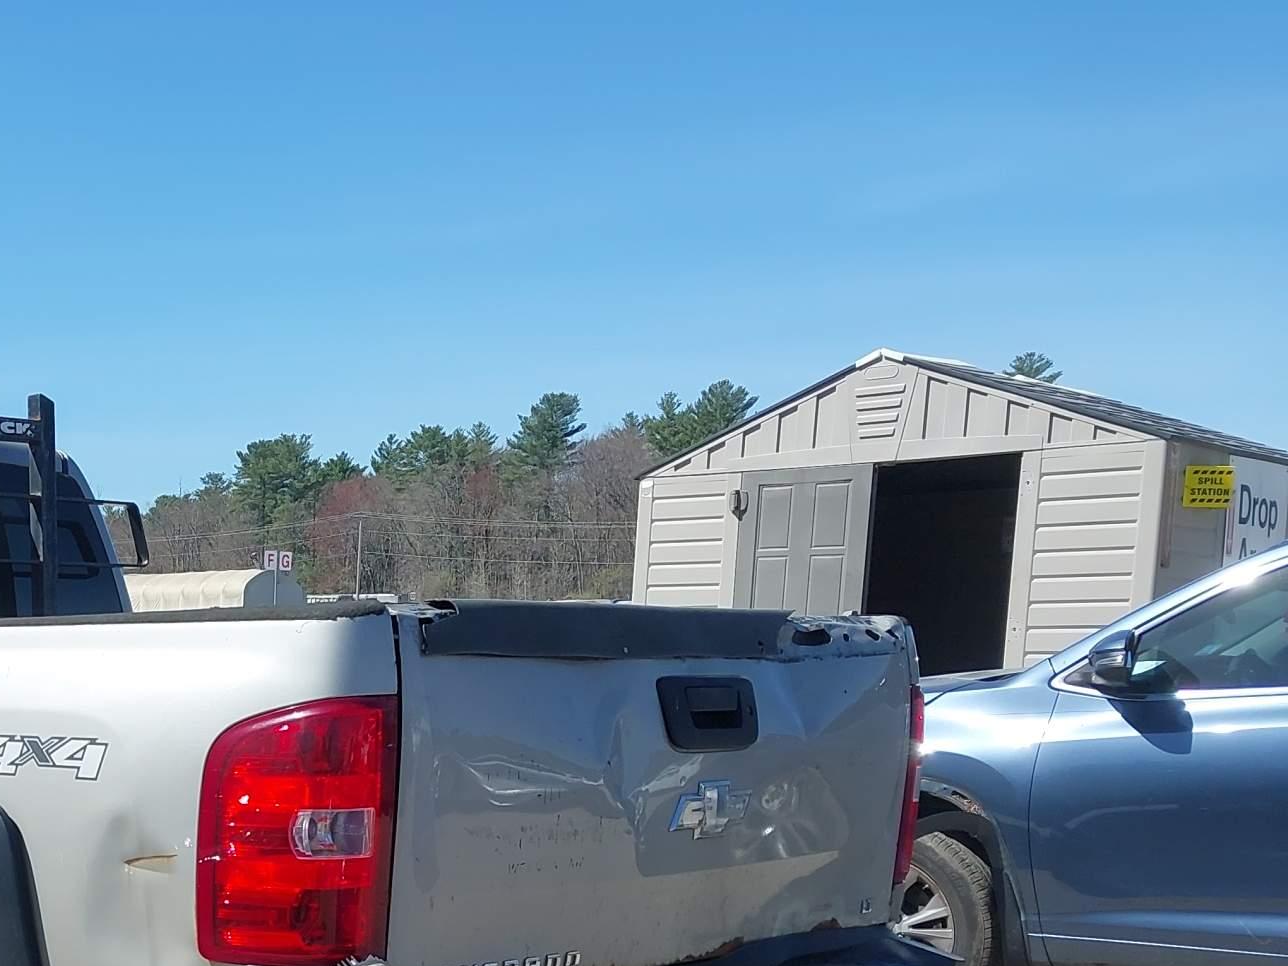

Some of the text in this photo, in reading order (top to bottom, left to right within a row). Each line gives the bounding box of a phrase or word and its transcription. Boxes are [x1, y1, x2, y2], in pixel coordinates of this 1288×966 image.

[1197, 476, 1225, 485] SPILL
[1190, 487, 1230, 496] STATION
[1238, 484, 1278, 538] Drop
[267, 553, 275, 568] F
[281, 554, 290, 569] G
